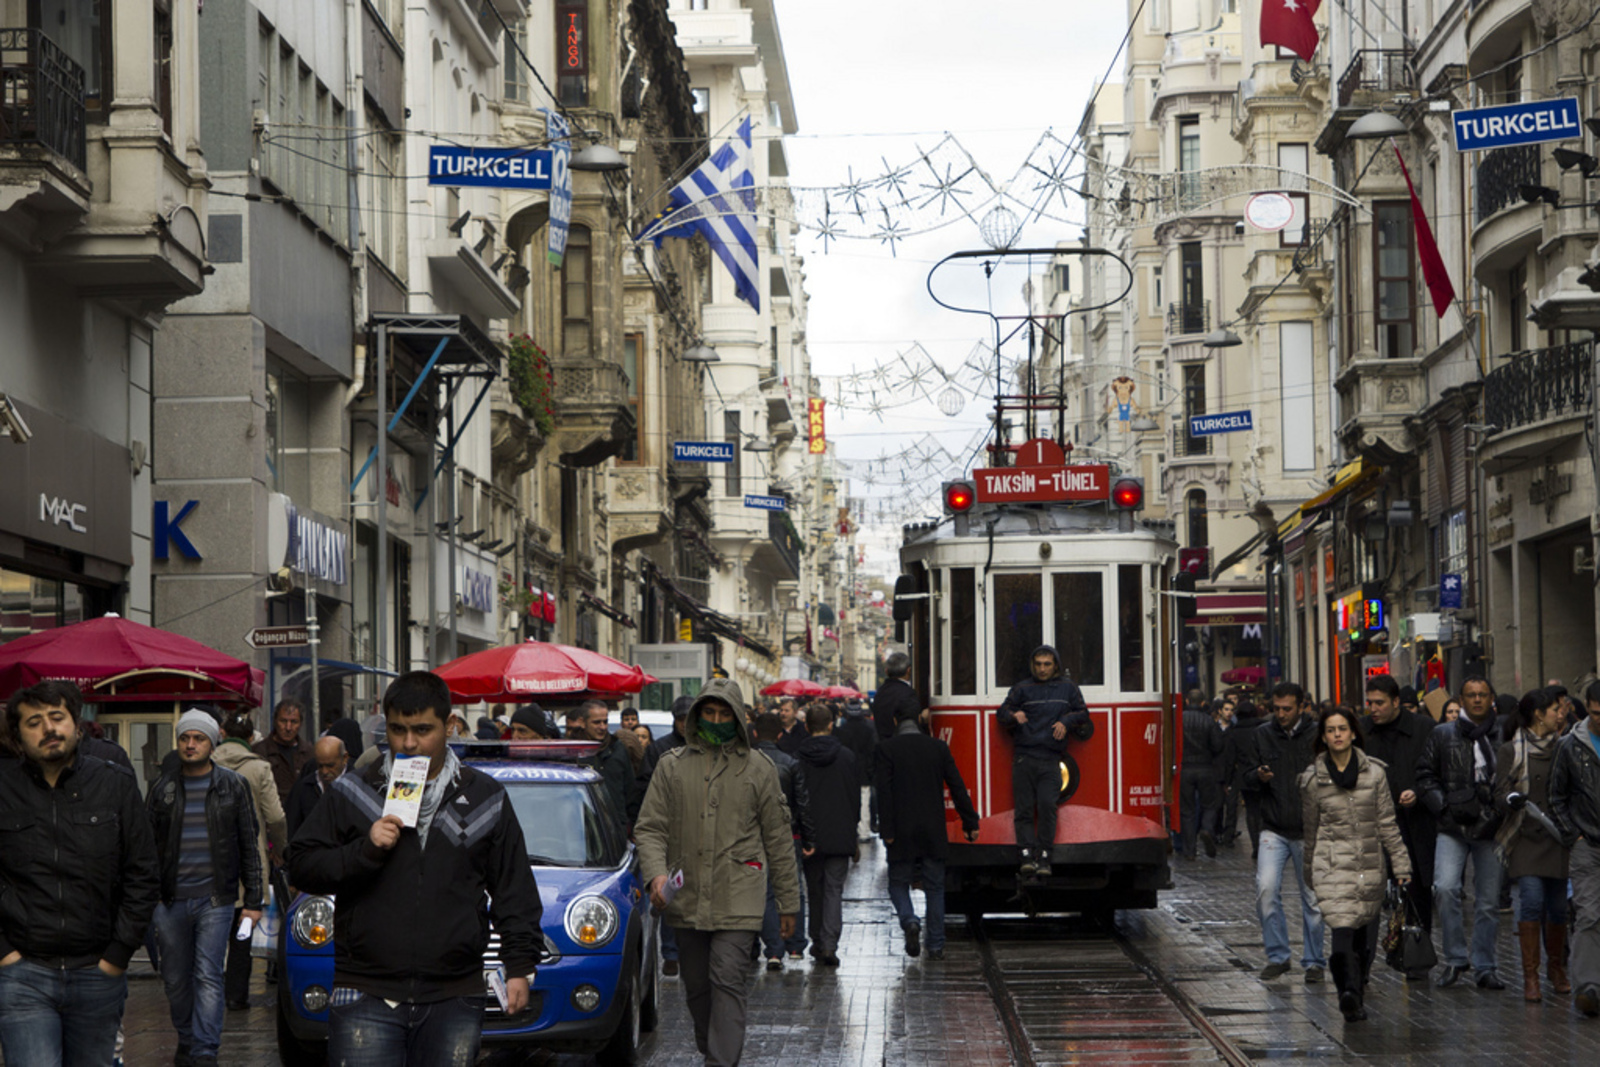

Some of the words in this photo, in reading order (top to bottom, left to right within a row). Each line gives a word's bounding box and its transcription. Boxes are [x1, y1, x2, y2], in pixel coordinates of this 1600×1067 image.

[568, 13, 579, 67] TANGO
[1457, 108, 1577, 140] TURKCELL
[433, 155, 549, 179] TURKCELL
[811, 398, 823, 437] TKP
[1192, 415, 1251, 432] TURKCELL
[675, 445, 732, 458] TURKCELL
[1036, 441, 1042, 464] 1
[985, 471, 1036, 494] TAKSİM
[1052, 470, 1100, 492] TÜNEL
[39, 492, 87, 534] MAC
[745, 497, 784, 508] TURKCELL
[154, 500, 203, 560] K
[1144, 723, 1158, 745] 47
[492, 767, 581, 780] ZABITA
